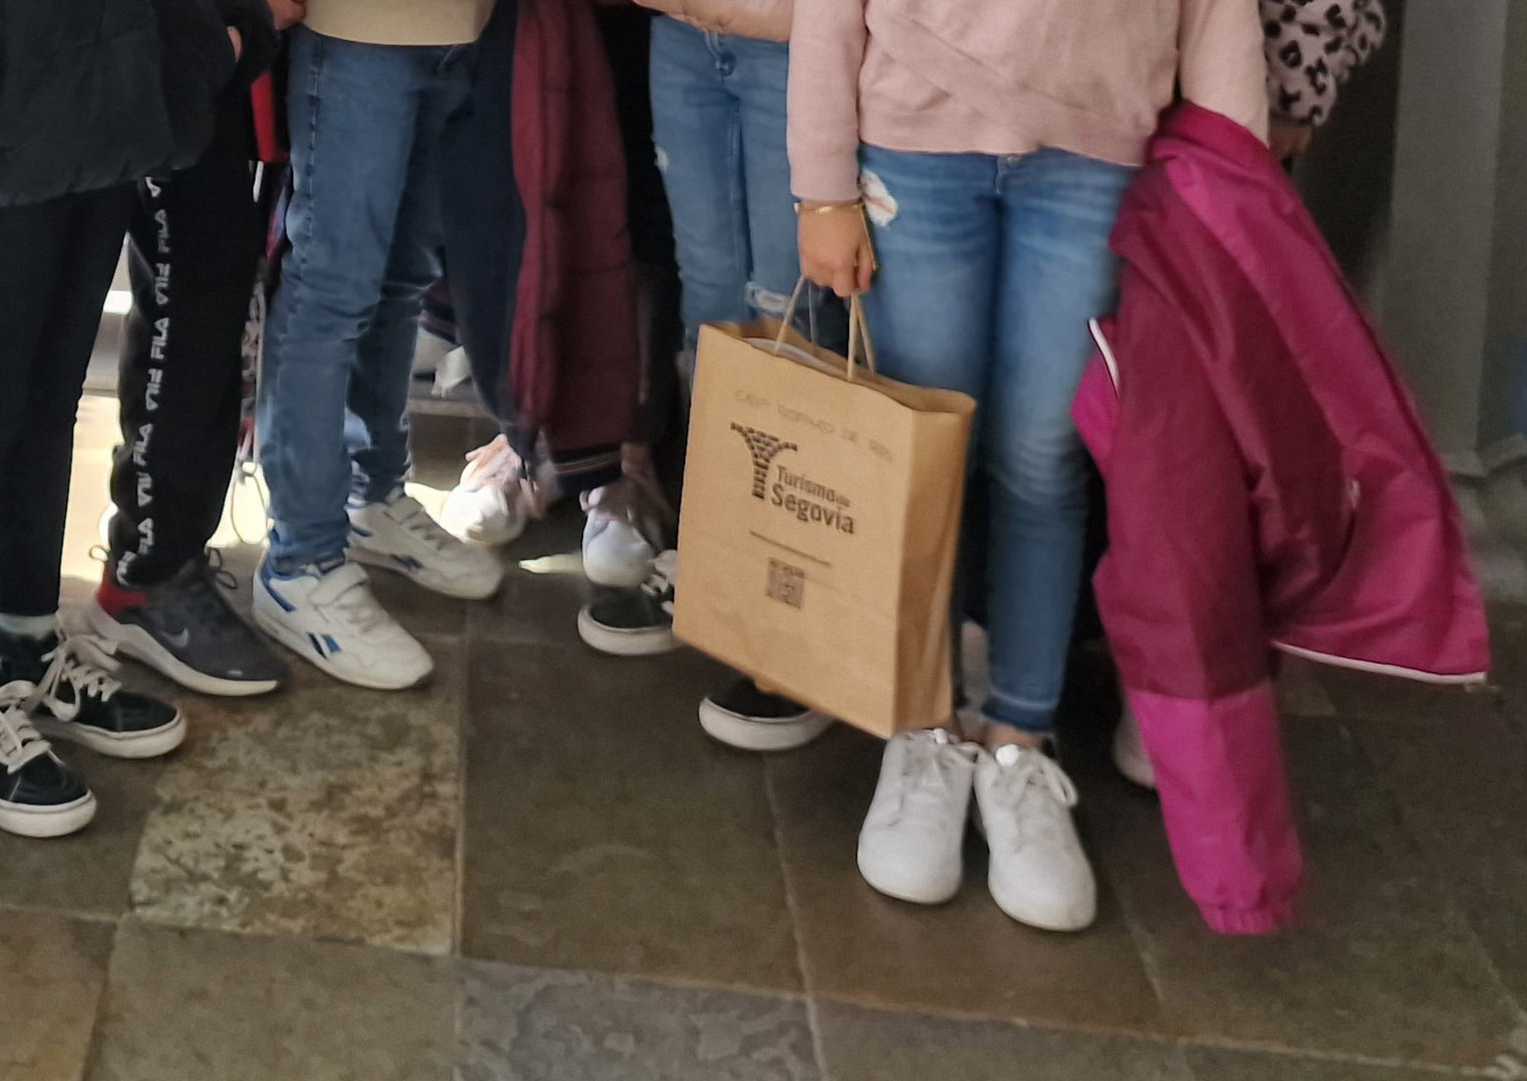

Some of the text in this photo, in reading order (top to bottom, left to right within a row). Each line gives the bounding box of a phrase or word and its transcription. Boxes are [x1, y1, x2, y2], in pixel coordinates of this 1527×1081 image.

[150, 317, 170, 359] FILA
[777, 465, 835, 502] Turismo
[771, 483, 855, 535] Segovia
